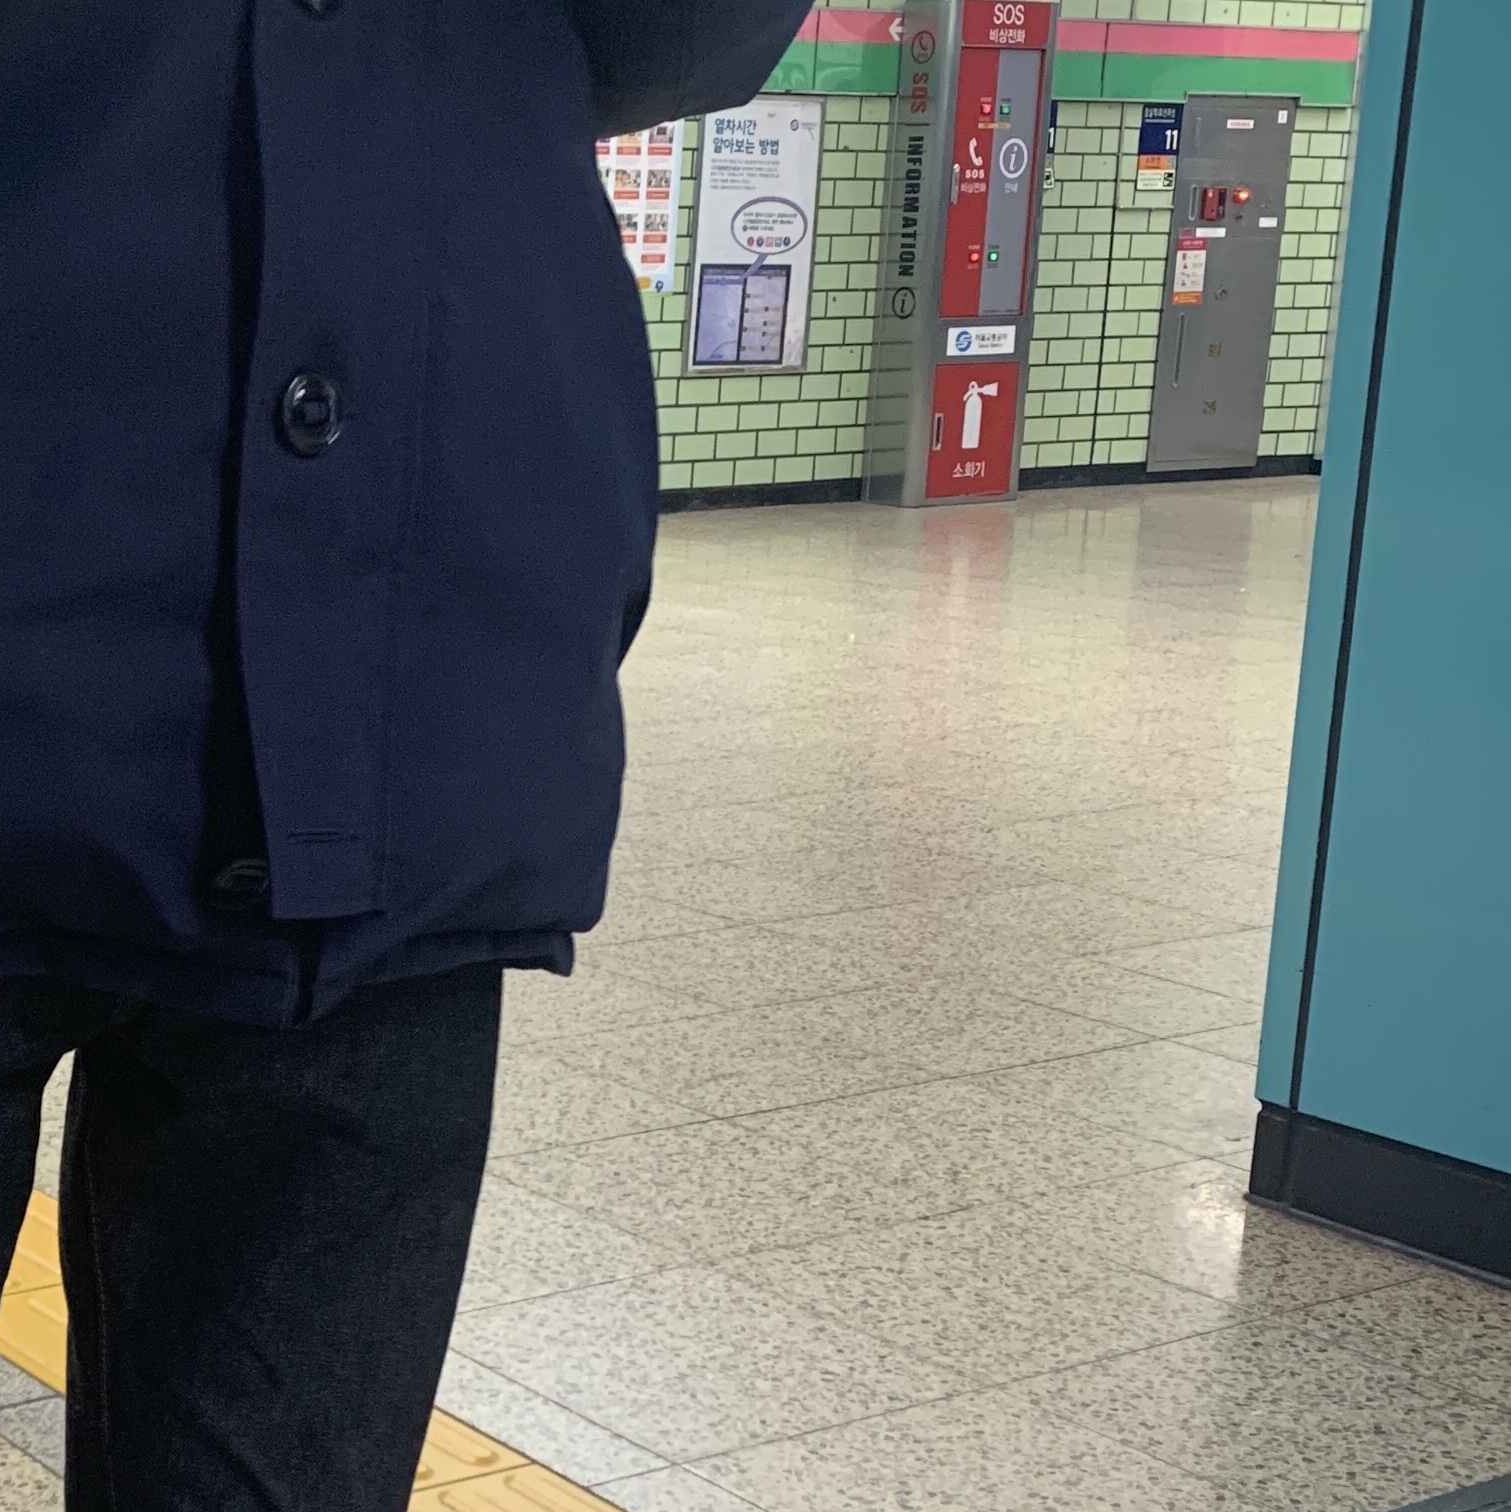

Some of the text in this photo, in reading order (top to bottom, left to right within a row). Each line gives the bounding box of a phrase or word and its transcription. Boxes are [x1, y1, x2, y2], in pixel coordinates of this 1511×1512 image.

[993, 3, 1025, 25] SOS
[989, 28, 1025, 44] 비상전화
[911, 72, 929, 113] SOS
[714, 118, 757, 136] 열차시간
[713, 137, 779, 155] 알아보는 방법
[1165, 129, 1178, 150] 11
[965, 169, 985, 179] SOS
[960, 182, 986, 193] 비상전화
[898, 136, 924, 277] INFORMATION
[952, 460, 985, 478] 소화기
